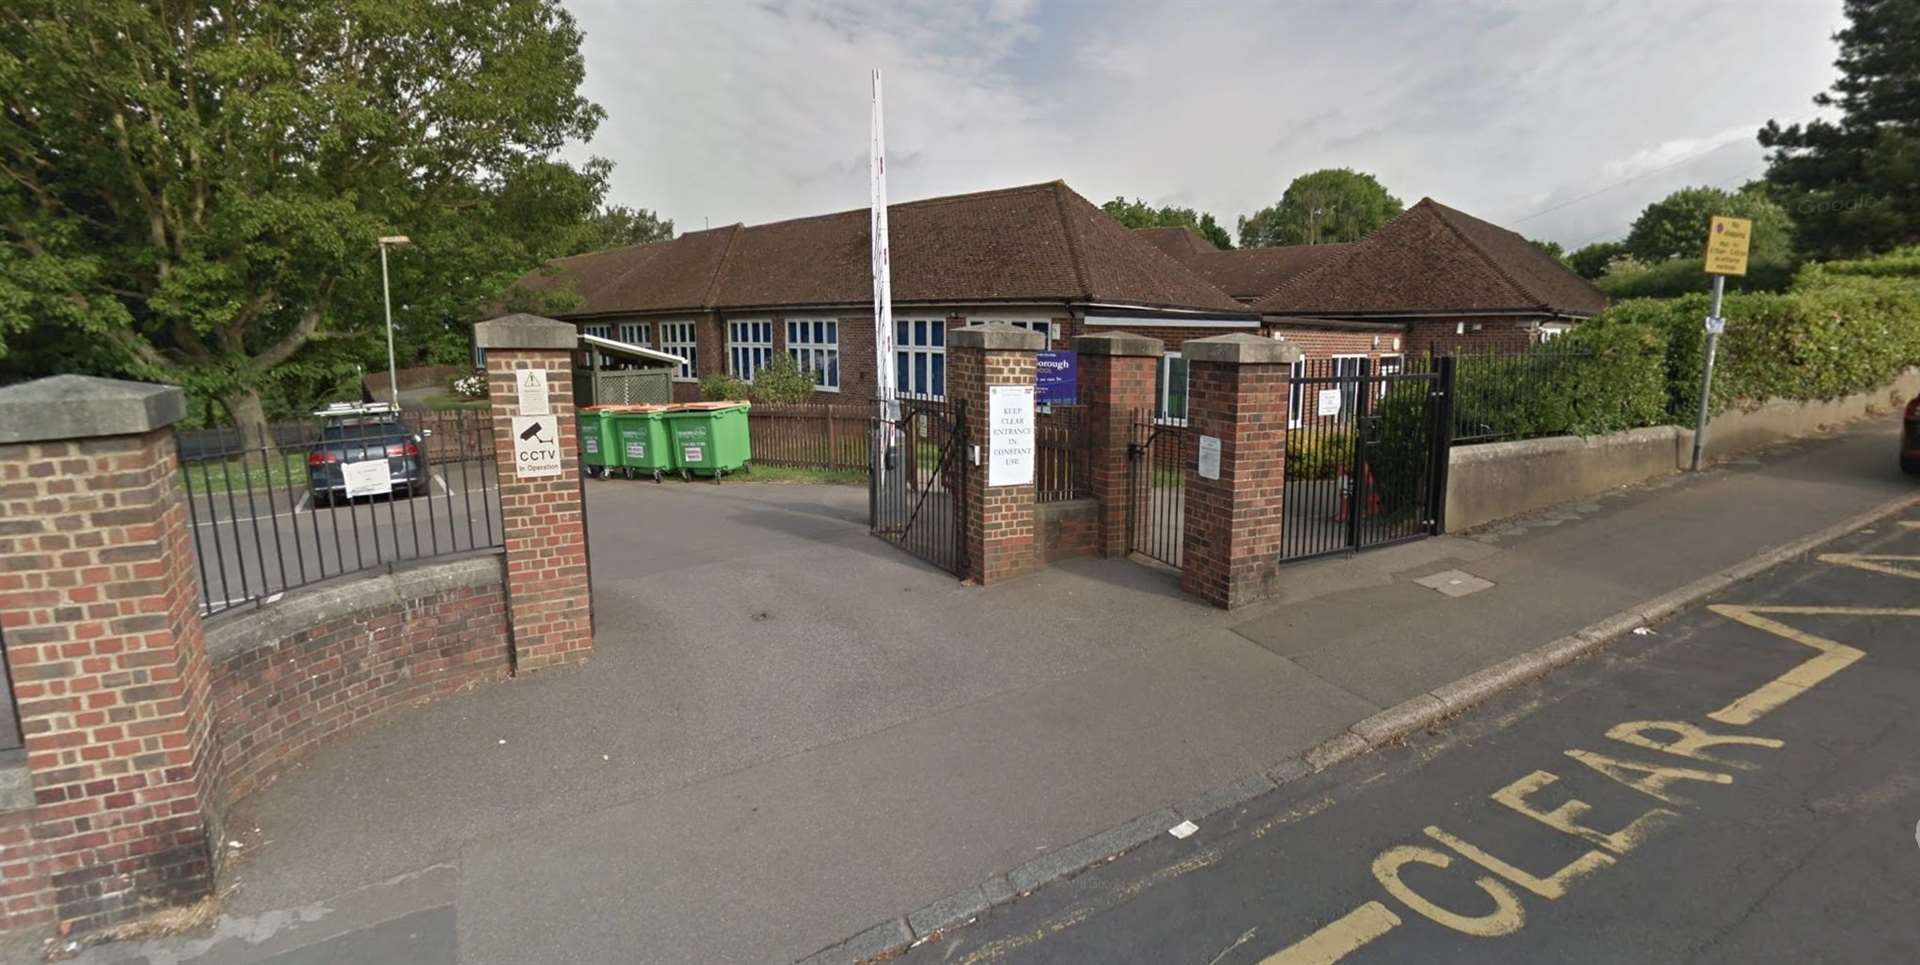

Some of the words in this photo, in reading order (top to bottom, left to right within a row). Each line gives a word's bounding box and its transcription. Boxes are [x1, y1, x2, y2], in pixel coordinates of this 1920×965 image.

[1001, 417, 1024, 425] CLEAR
[993, 427, 1031, 436] ENTRANCE
[519, 450, 556, 462] CCTV
[993, 447, 1031, 456] CONSTANT
[1005, 458, 1020, 466] USE
[527, 463, 559, 472] Operation
[1371, 720, 1784, 937] CLEAR
